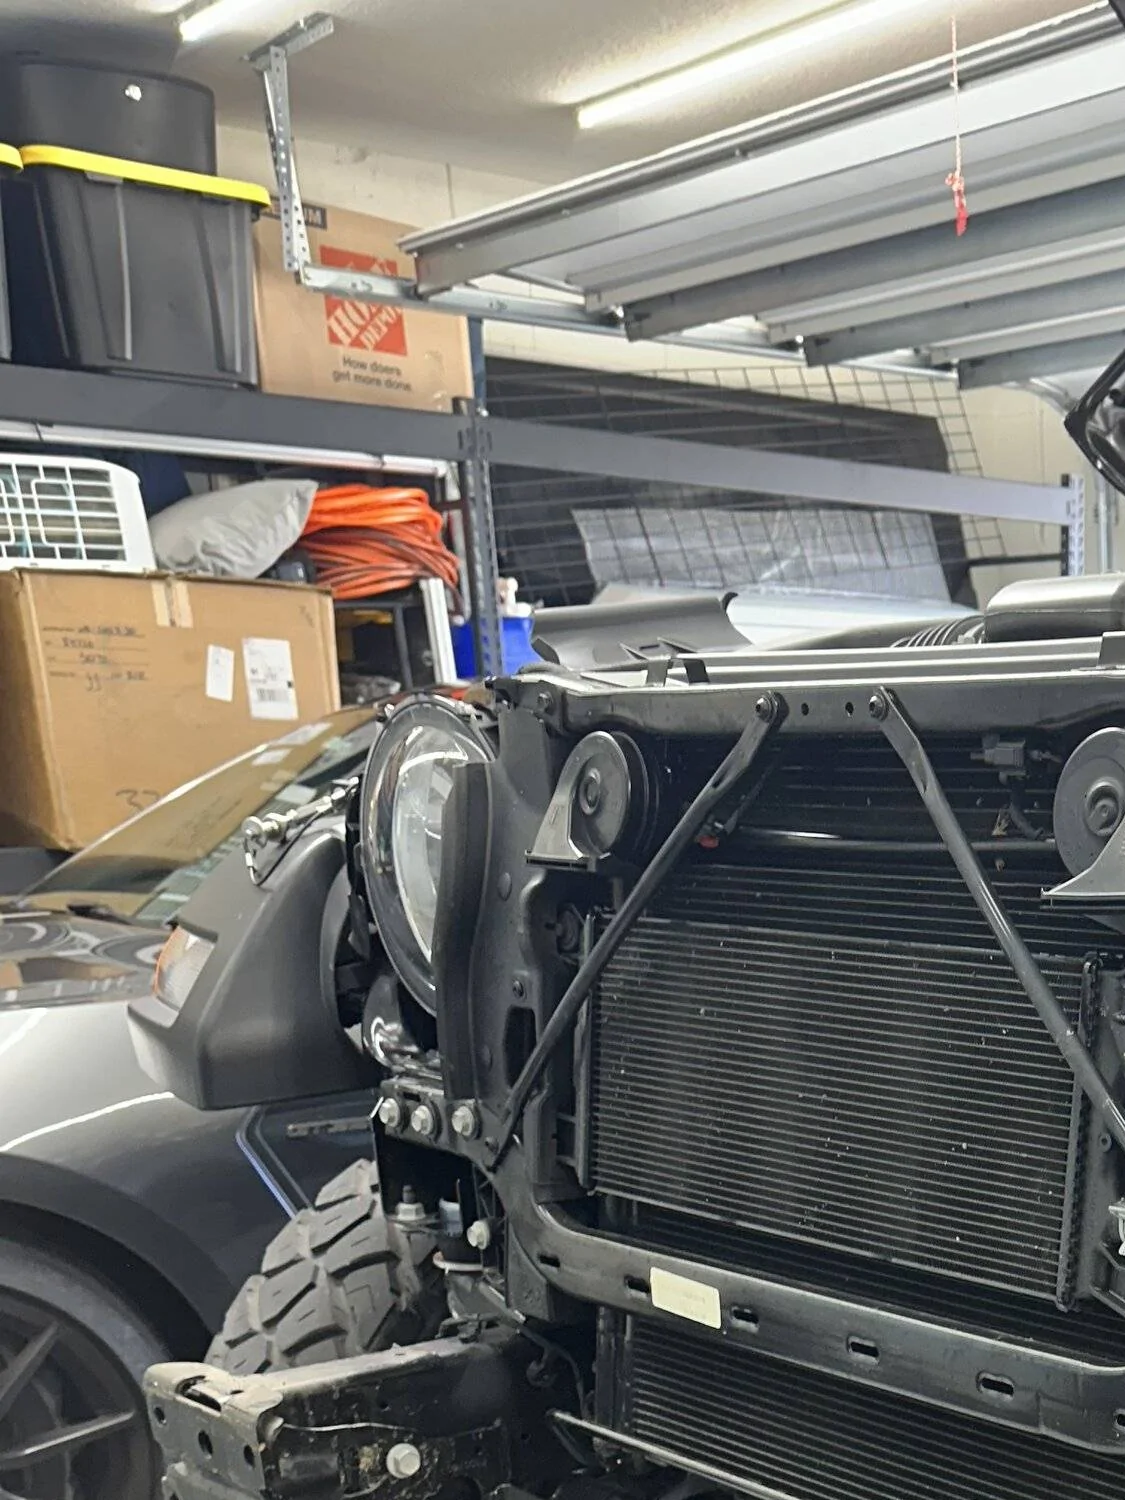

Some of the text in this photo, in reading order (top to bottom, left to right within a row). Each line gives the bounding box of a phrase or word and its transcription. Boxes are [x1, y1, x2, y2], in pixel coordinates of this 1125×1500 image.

[342, 355, 402, 376] How doers
[331, 369, 351, 383] get
[353, 373, 382, 387] more
